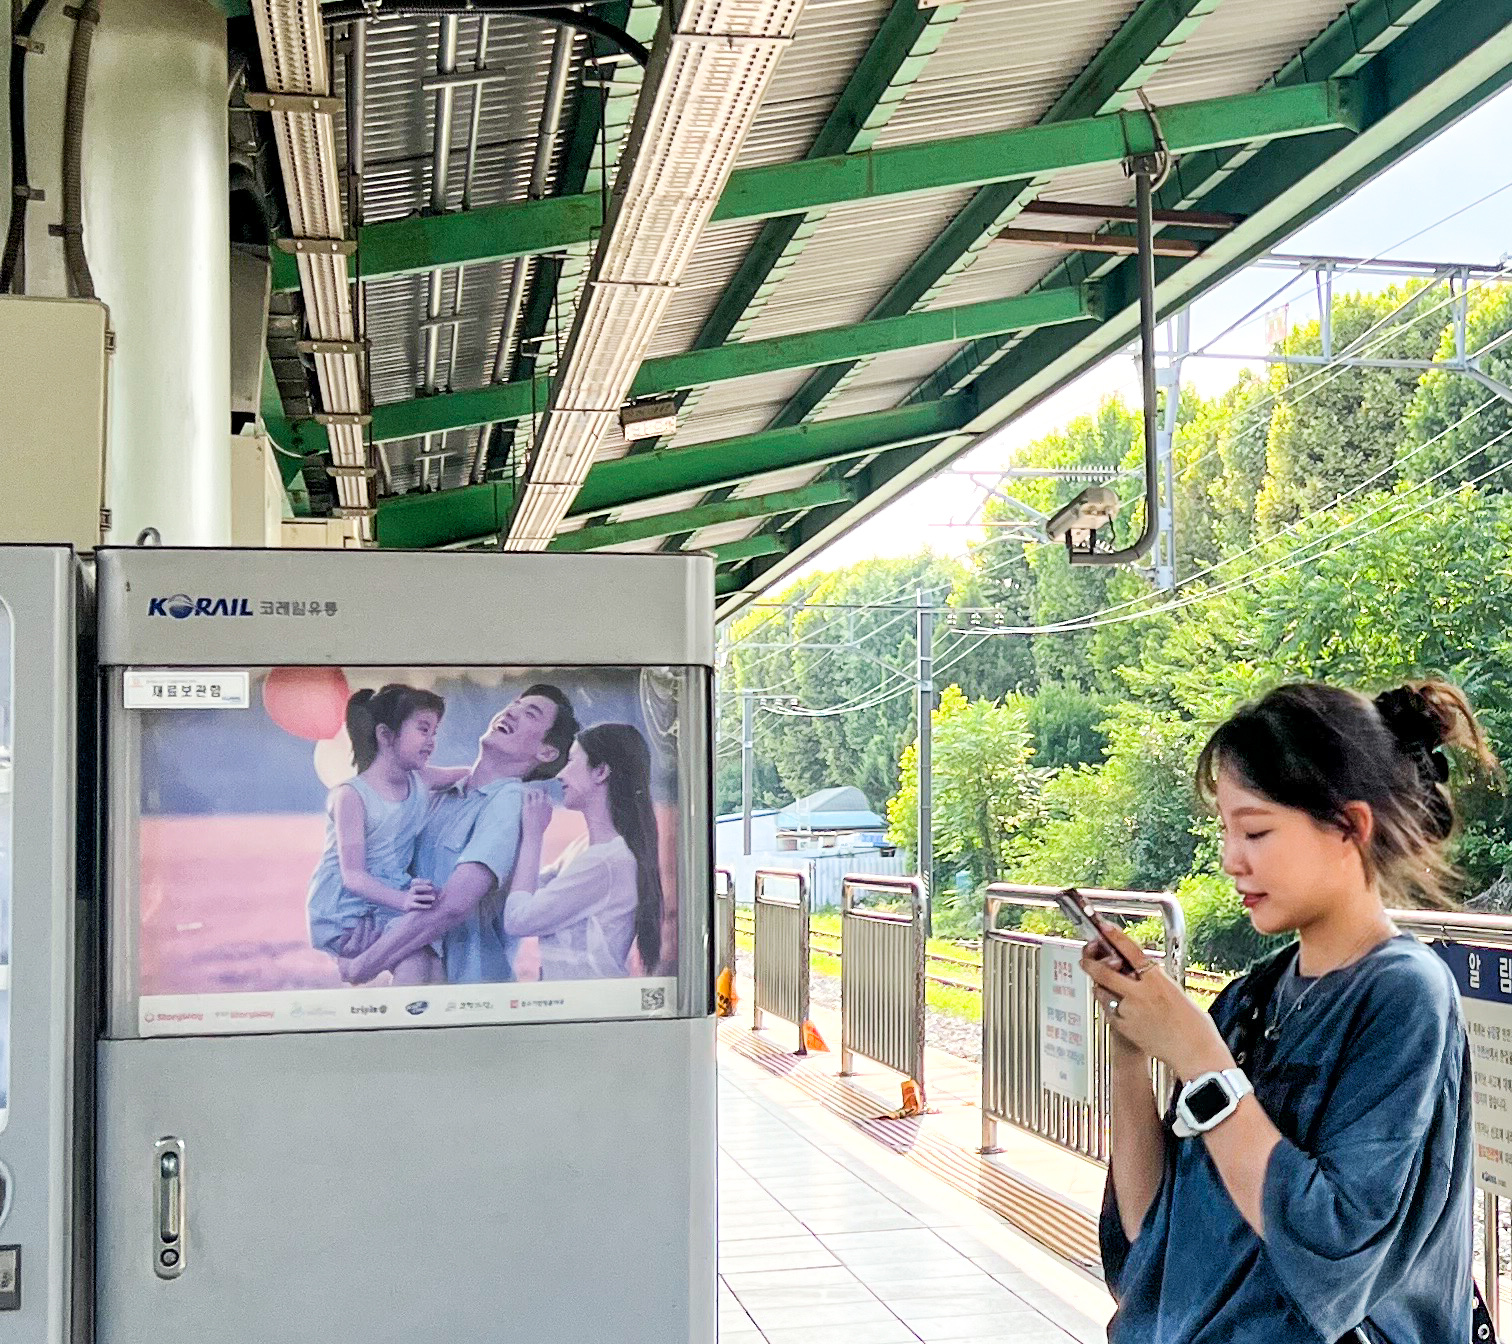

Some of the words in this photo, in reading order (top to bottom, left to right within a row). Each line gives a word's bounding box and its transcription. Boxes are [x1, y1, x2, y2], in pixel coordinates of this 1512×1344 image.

[148, 593, 254, 619] KORAIL
[259, 600, 338, 617] 코레일유통
[152, 684, 222, 698] 재료보관함
